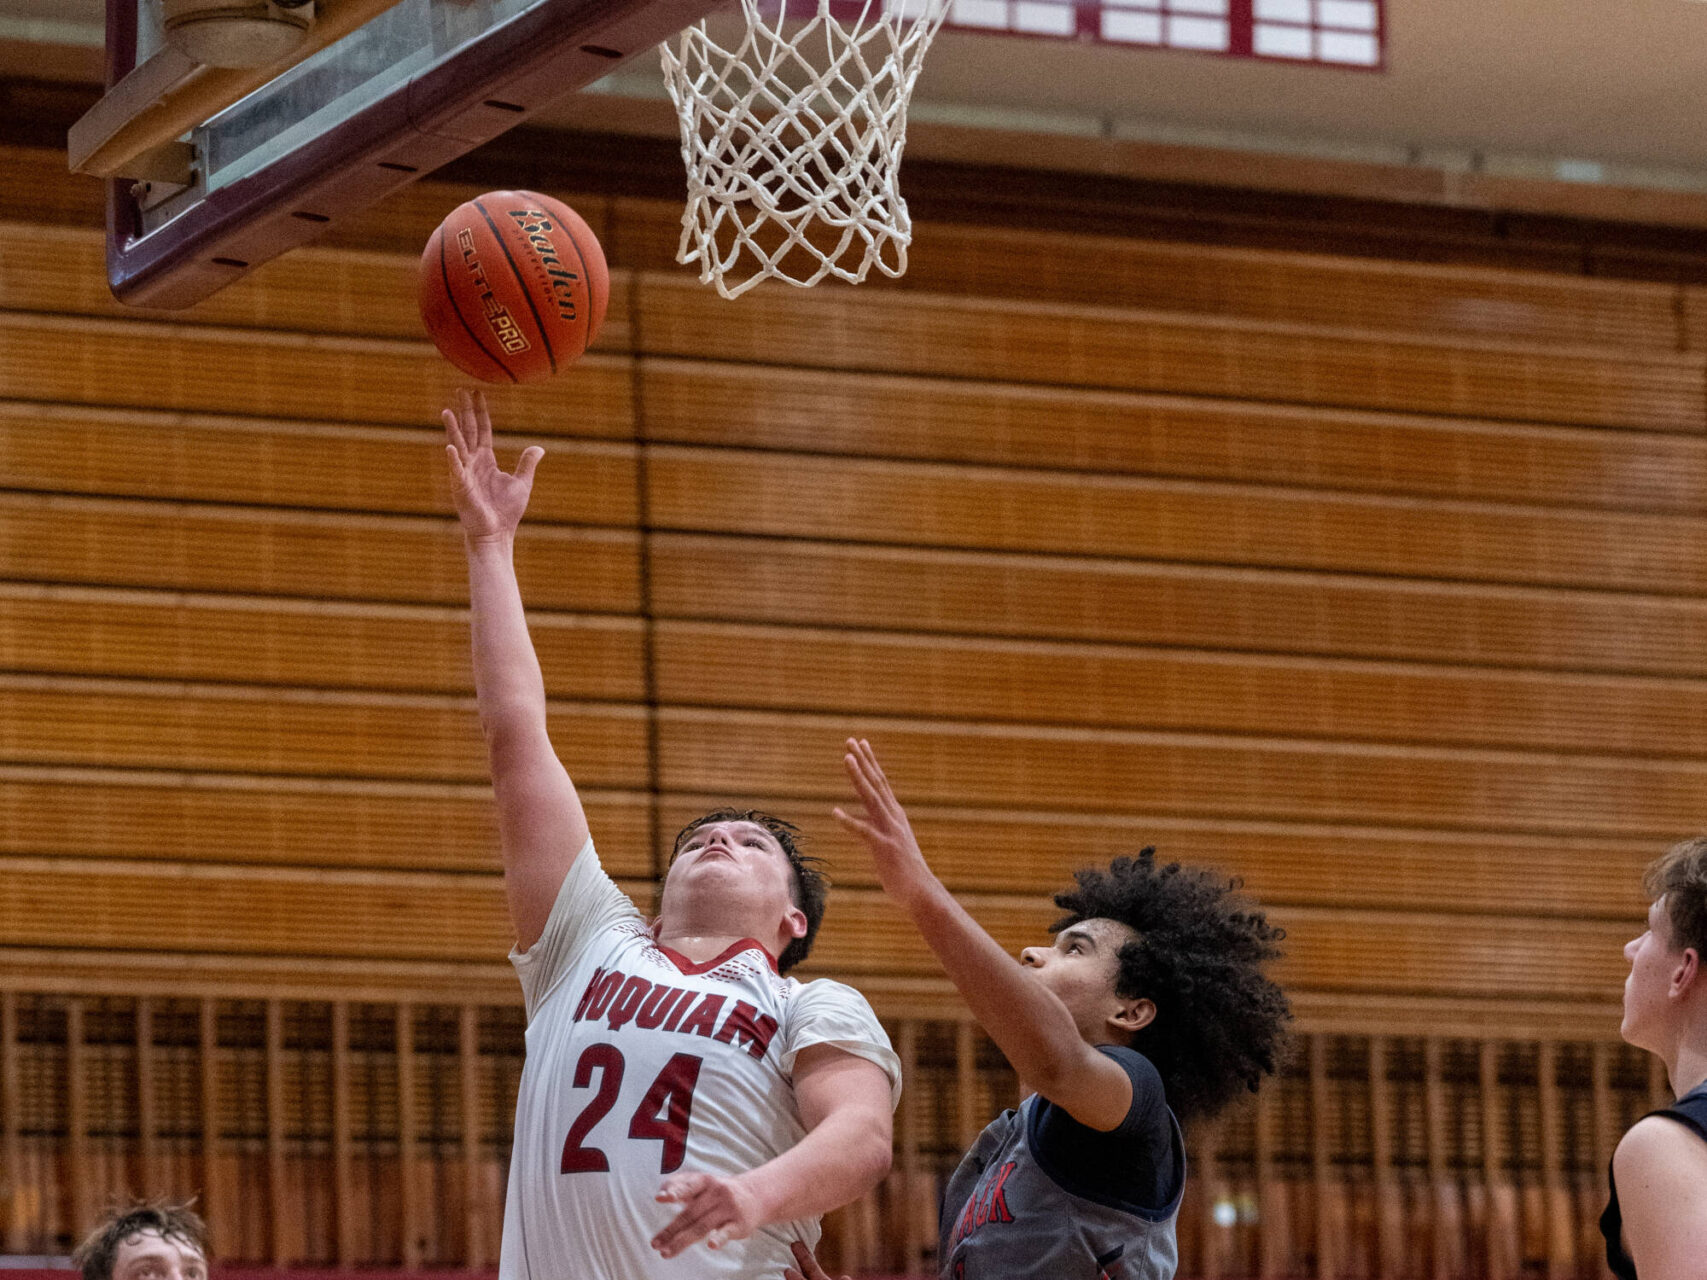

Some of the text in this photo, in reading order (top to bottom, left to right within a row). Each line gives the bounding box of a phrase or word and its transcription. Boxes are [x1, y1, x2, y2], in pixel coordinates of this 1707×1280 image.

[507, 209, 577, 320] Baden
[493, 315, 525, 352] PRO
[561, 1042, 703, 1174] 24
[950, 1161, 1017, 1249] ACK
